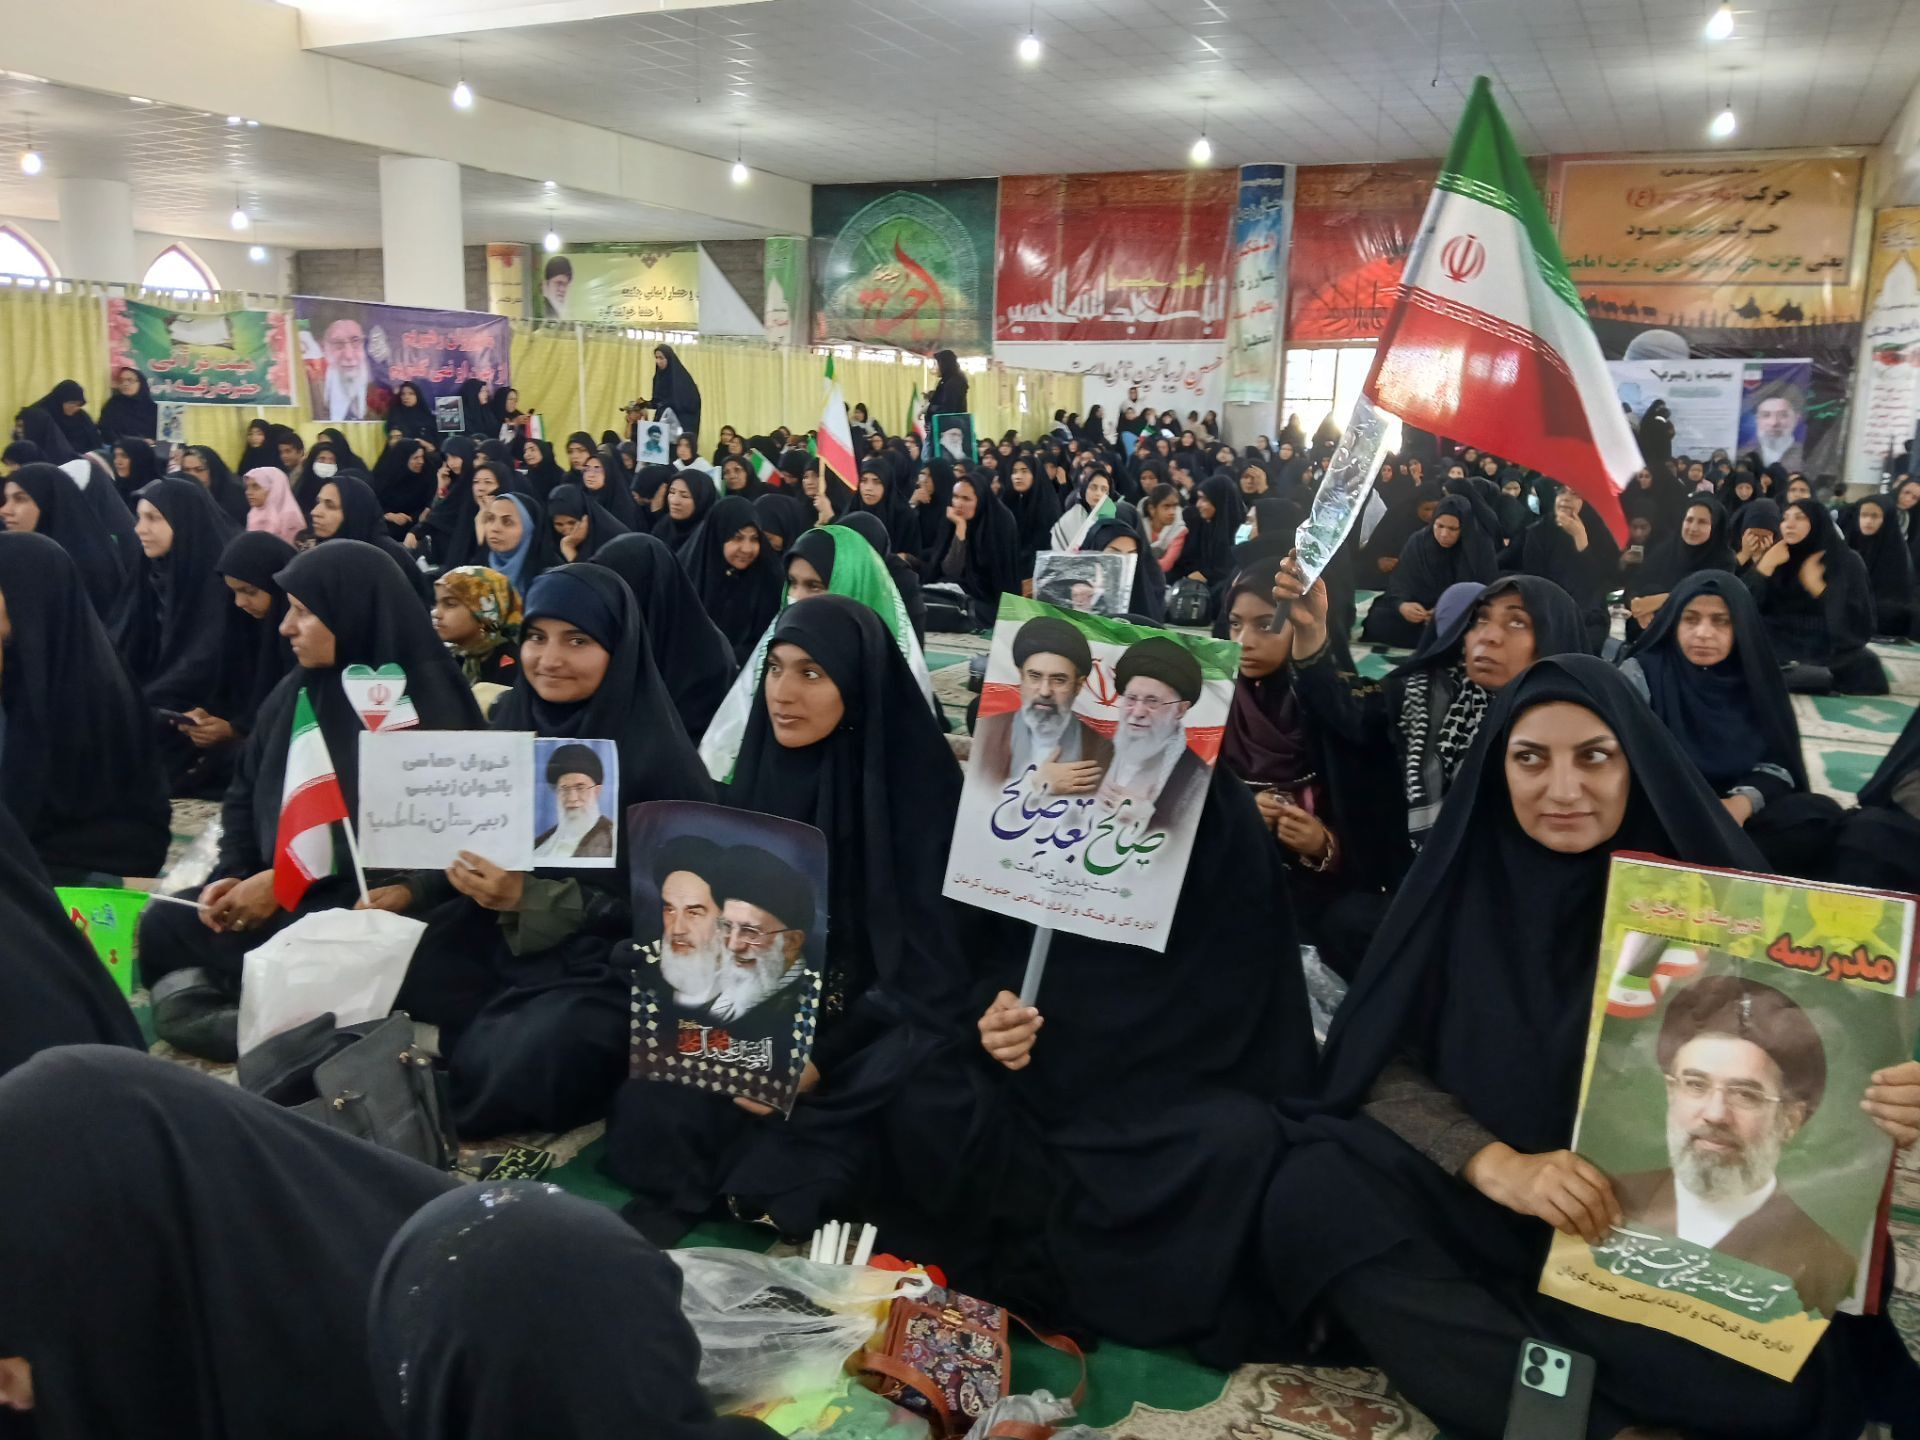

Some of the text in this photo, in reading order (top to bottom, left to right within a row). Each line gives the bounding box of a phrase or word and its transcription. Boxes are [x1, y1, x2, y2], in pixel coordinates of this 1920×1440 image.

[991, 763, 1069, 841] صالح
[1083, 798, 1166, 876] صالح
[1765, 931, 1897, 986] مدرسه
[1588, 1279, 1618, 1292] جنوب
[1618, 1292, 1659, 1304] اسلامی
[1689, 1310, 1699, 1320] و
[1701, 1313, 1741, 1333] فرهنگ
[1740, 1329, 1762, 1341] کل
[1761, 1338, 1795, 1354] اداره
